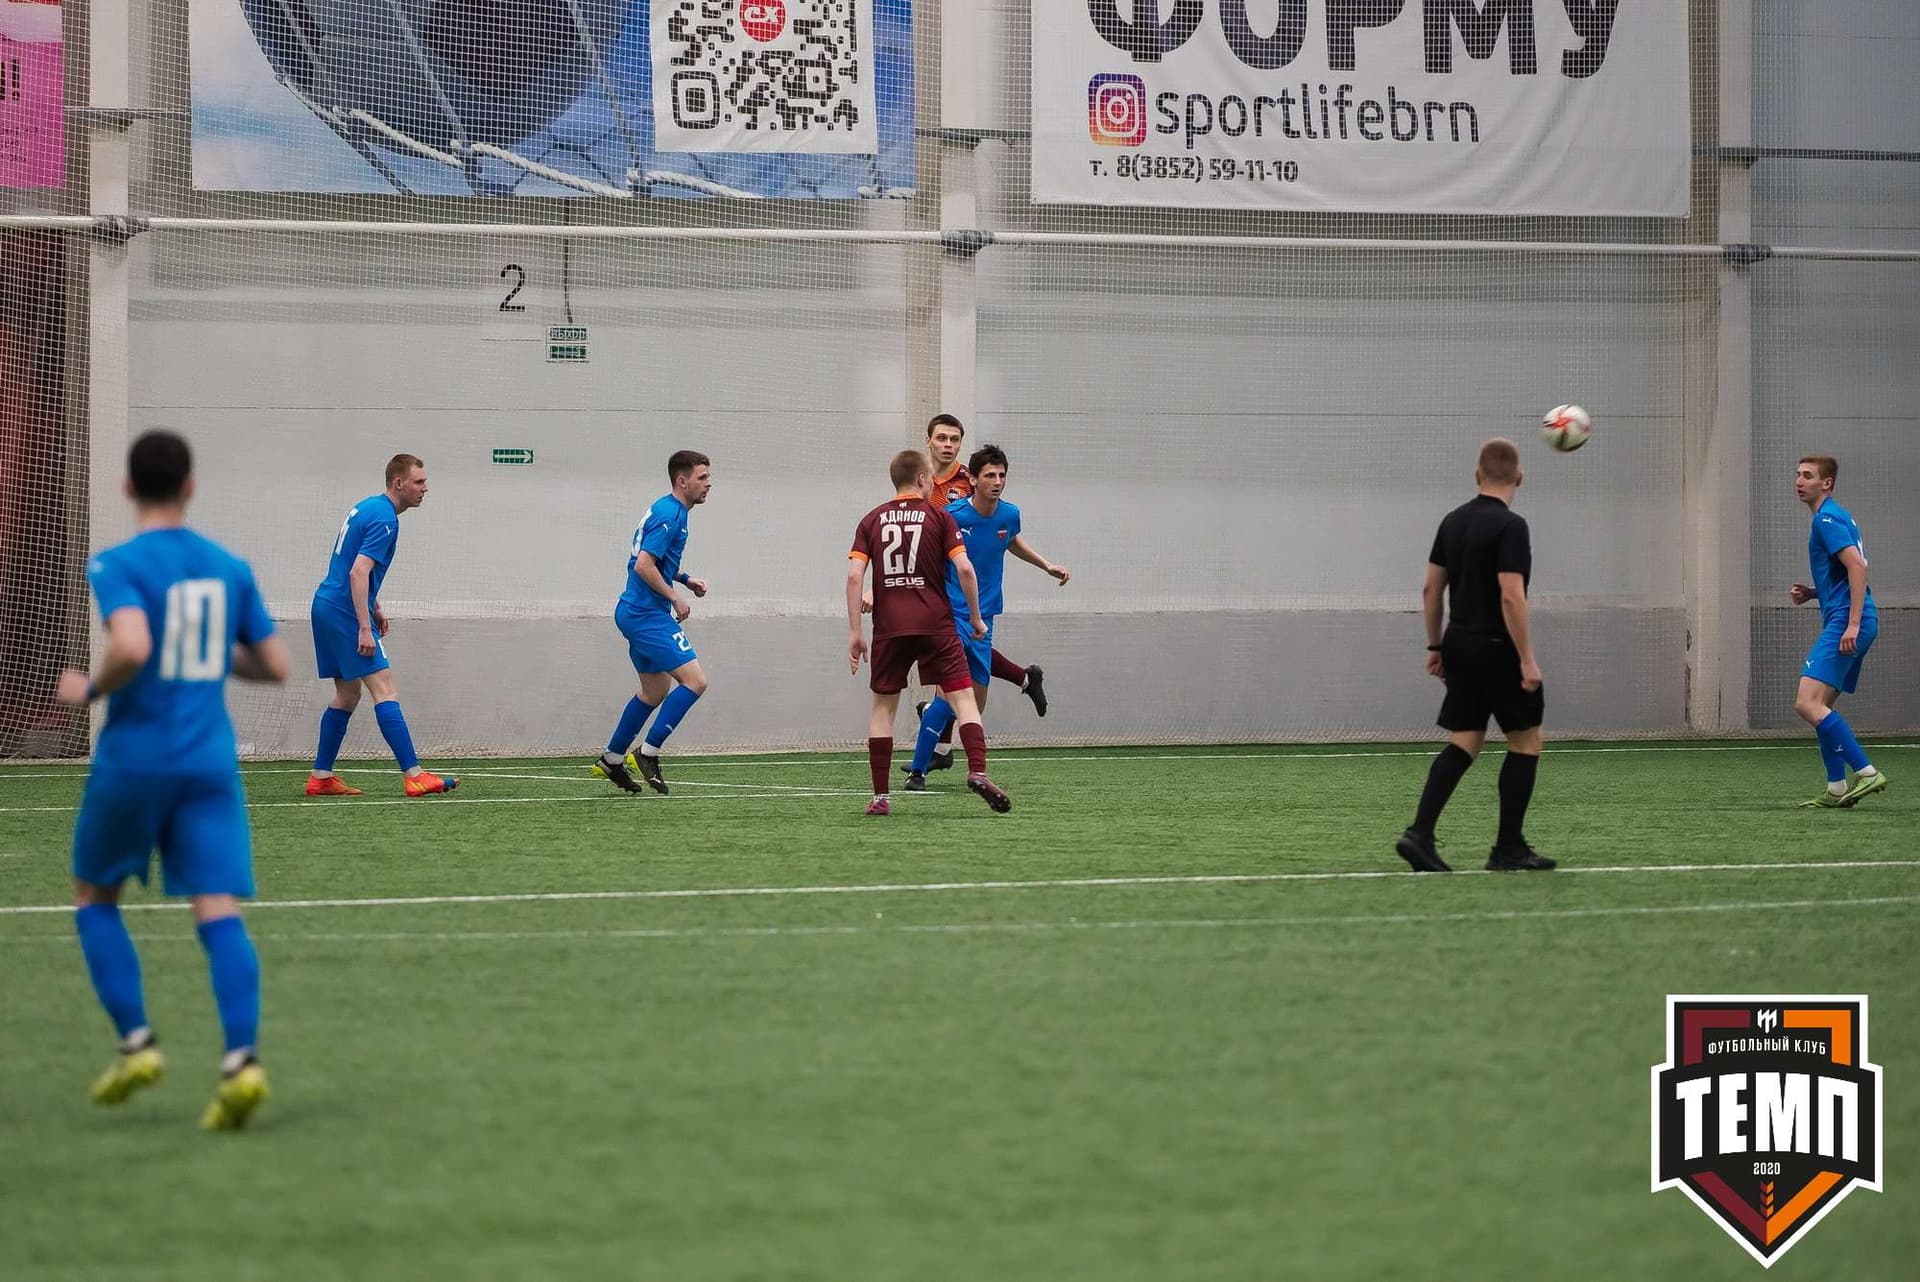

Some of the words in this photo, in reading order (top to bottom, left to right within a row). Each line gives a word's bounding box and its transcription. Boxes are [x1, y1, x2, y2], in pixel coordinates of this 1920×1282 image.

[1155, 83, 1480, 149] sportlifebrn
[1117, 154, 1204, 183] 8(3852)
[1209, 158, 1299, 183] 59-11-10
[500, 264, 526, 312] 2
[880, 510, 926, 523] ЖДАНОВ
[881, 523, 923, 575] 27
[160, 579, 227, 681] 10
